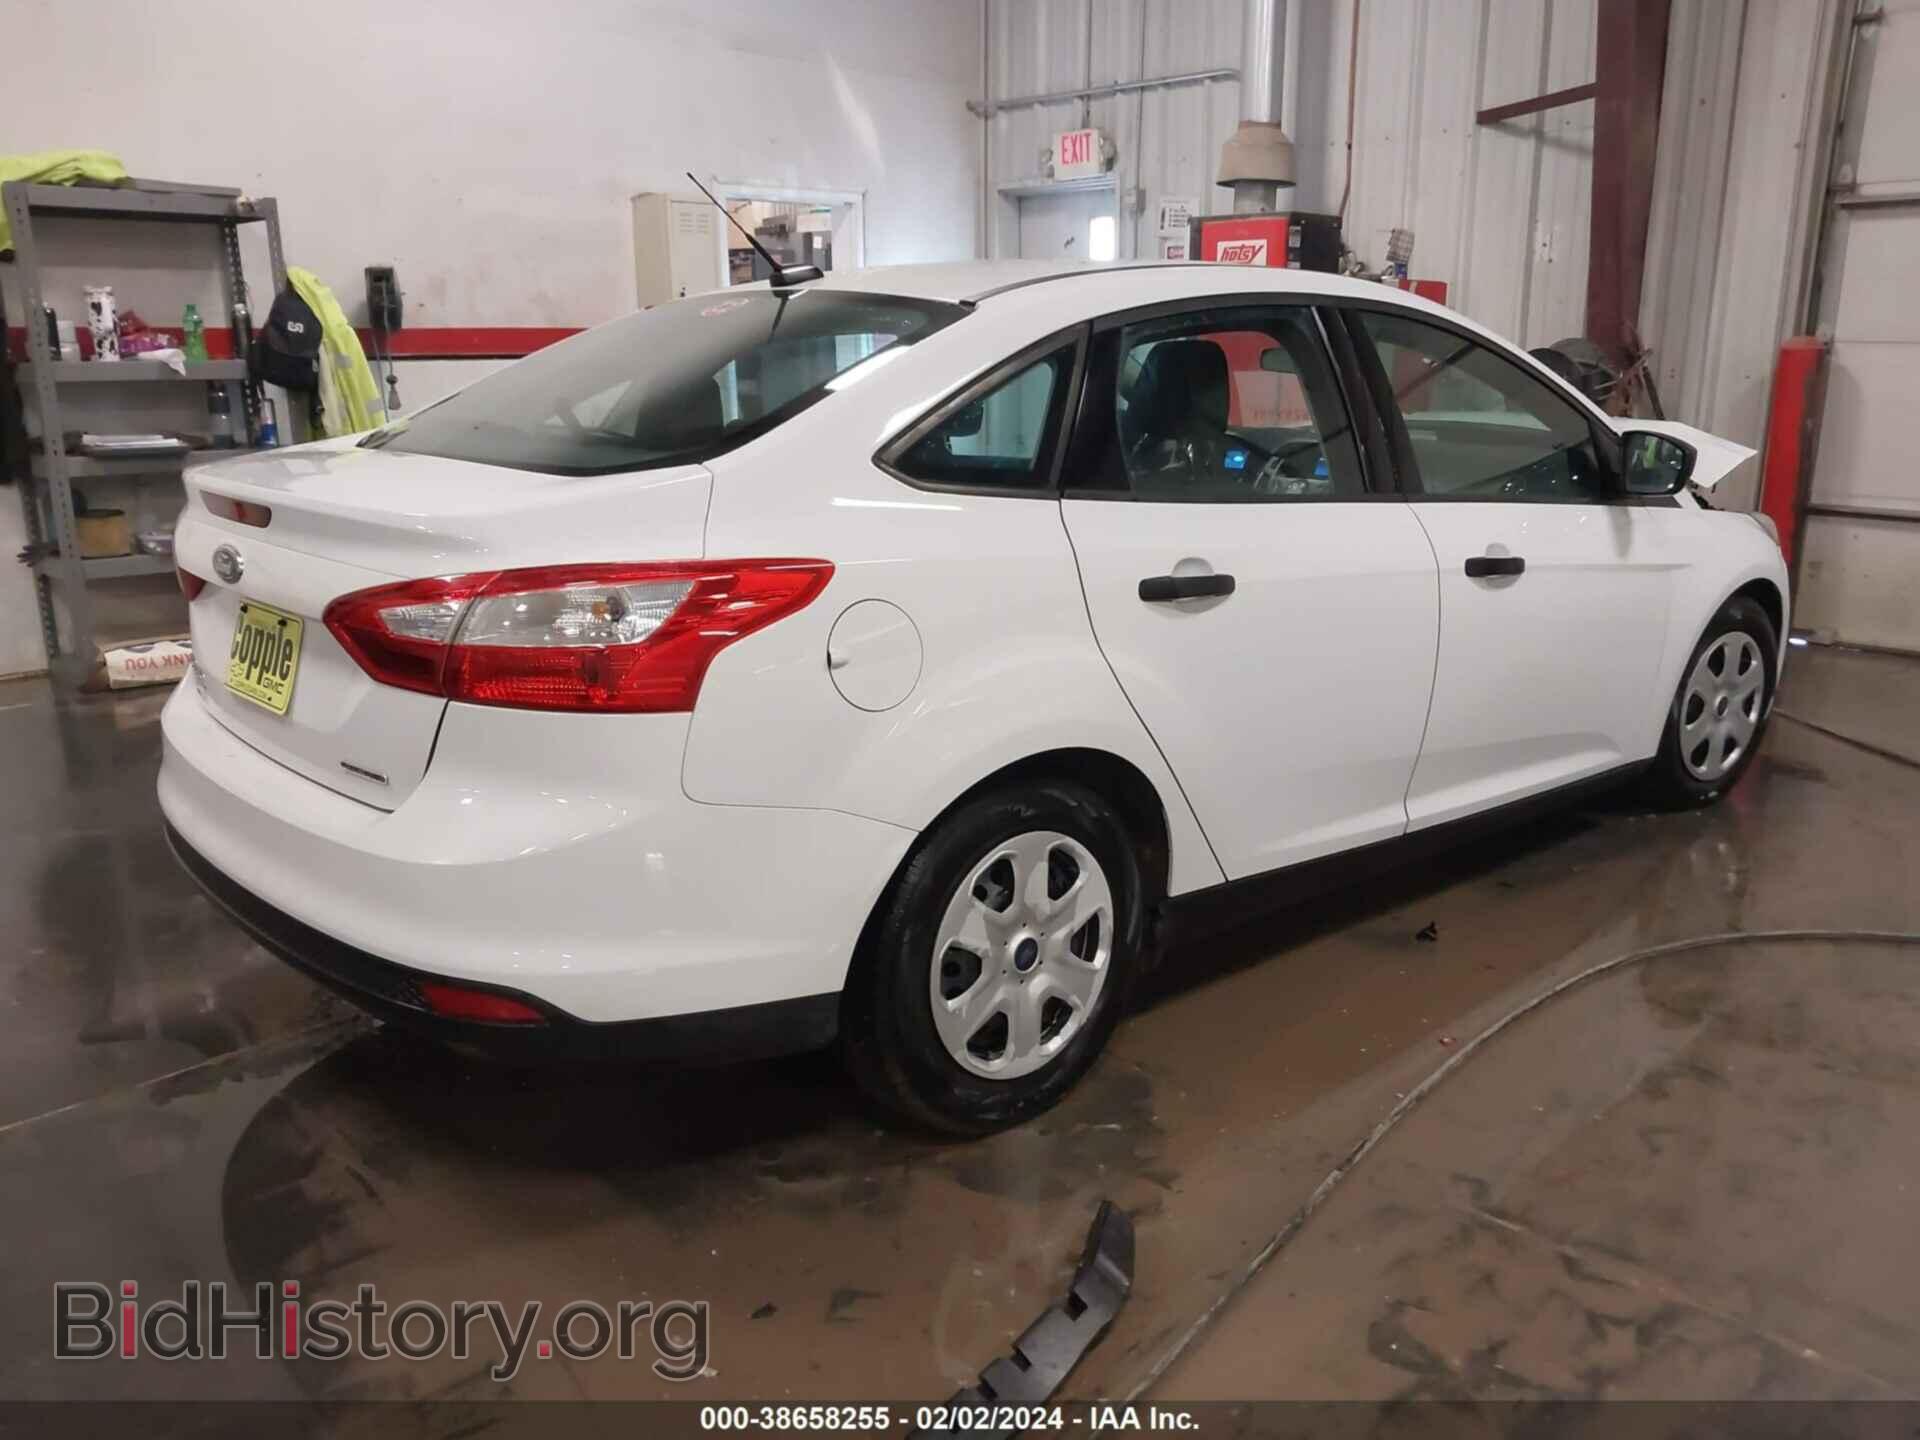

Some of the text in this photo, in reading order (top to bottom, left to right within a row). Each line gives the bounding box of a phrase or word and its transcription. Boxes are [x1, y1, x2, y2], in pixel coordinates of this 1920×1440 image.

[1061, 133, 1091, 164] EXIT
[125, 652, 192, 670] ANK YOU
[231, 610, 293, 685] Copple
